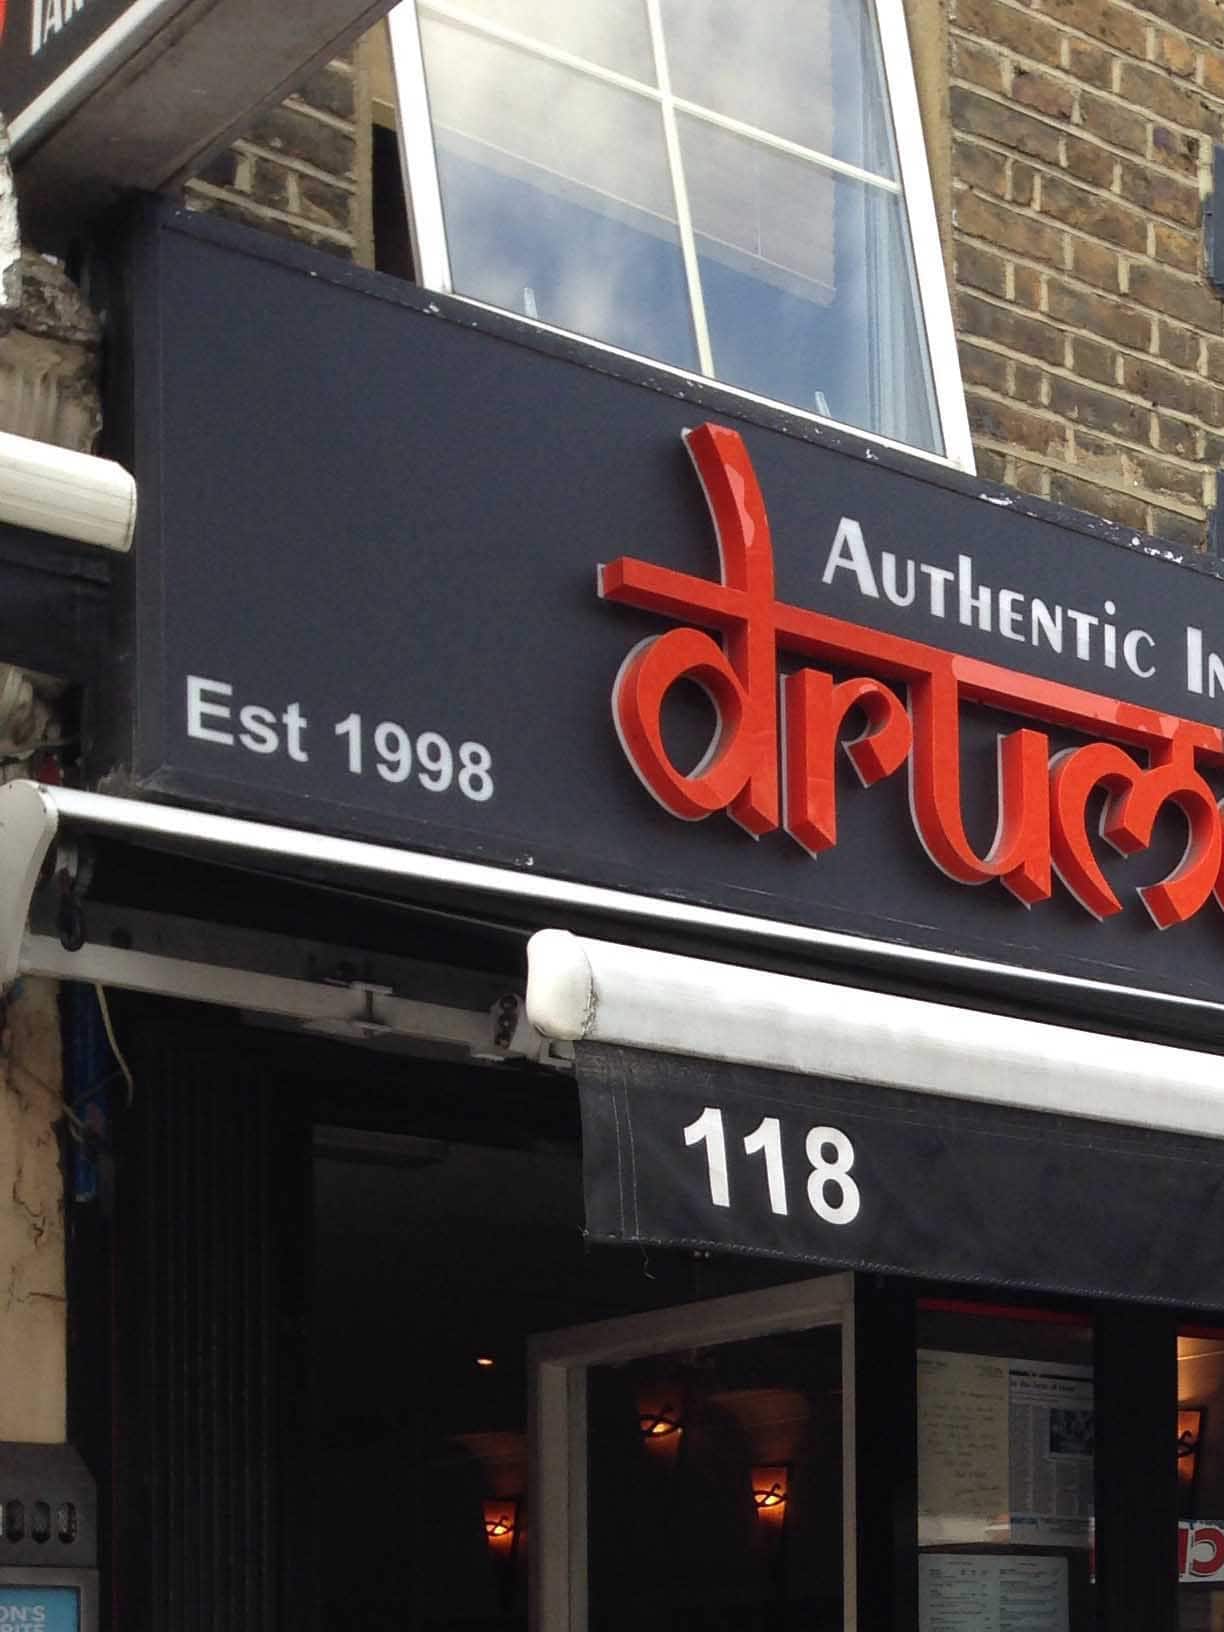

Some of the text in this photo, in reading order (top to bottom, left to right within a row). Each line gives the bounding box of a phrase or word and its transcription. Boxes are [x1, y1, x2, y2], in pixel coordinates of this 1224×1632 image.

[186, 675, 495, 803] Est 1998
[684, 1107, 860, 1225] 118
